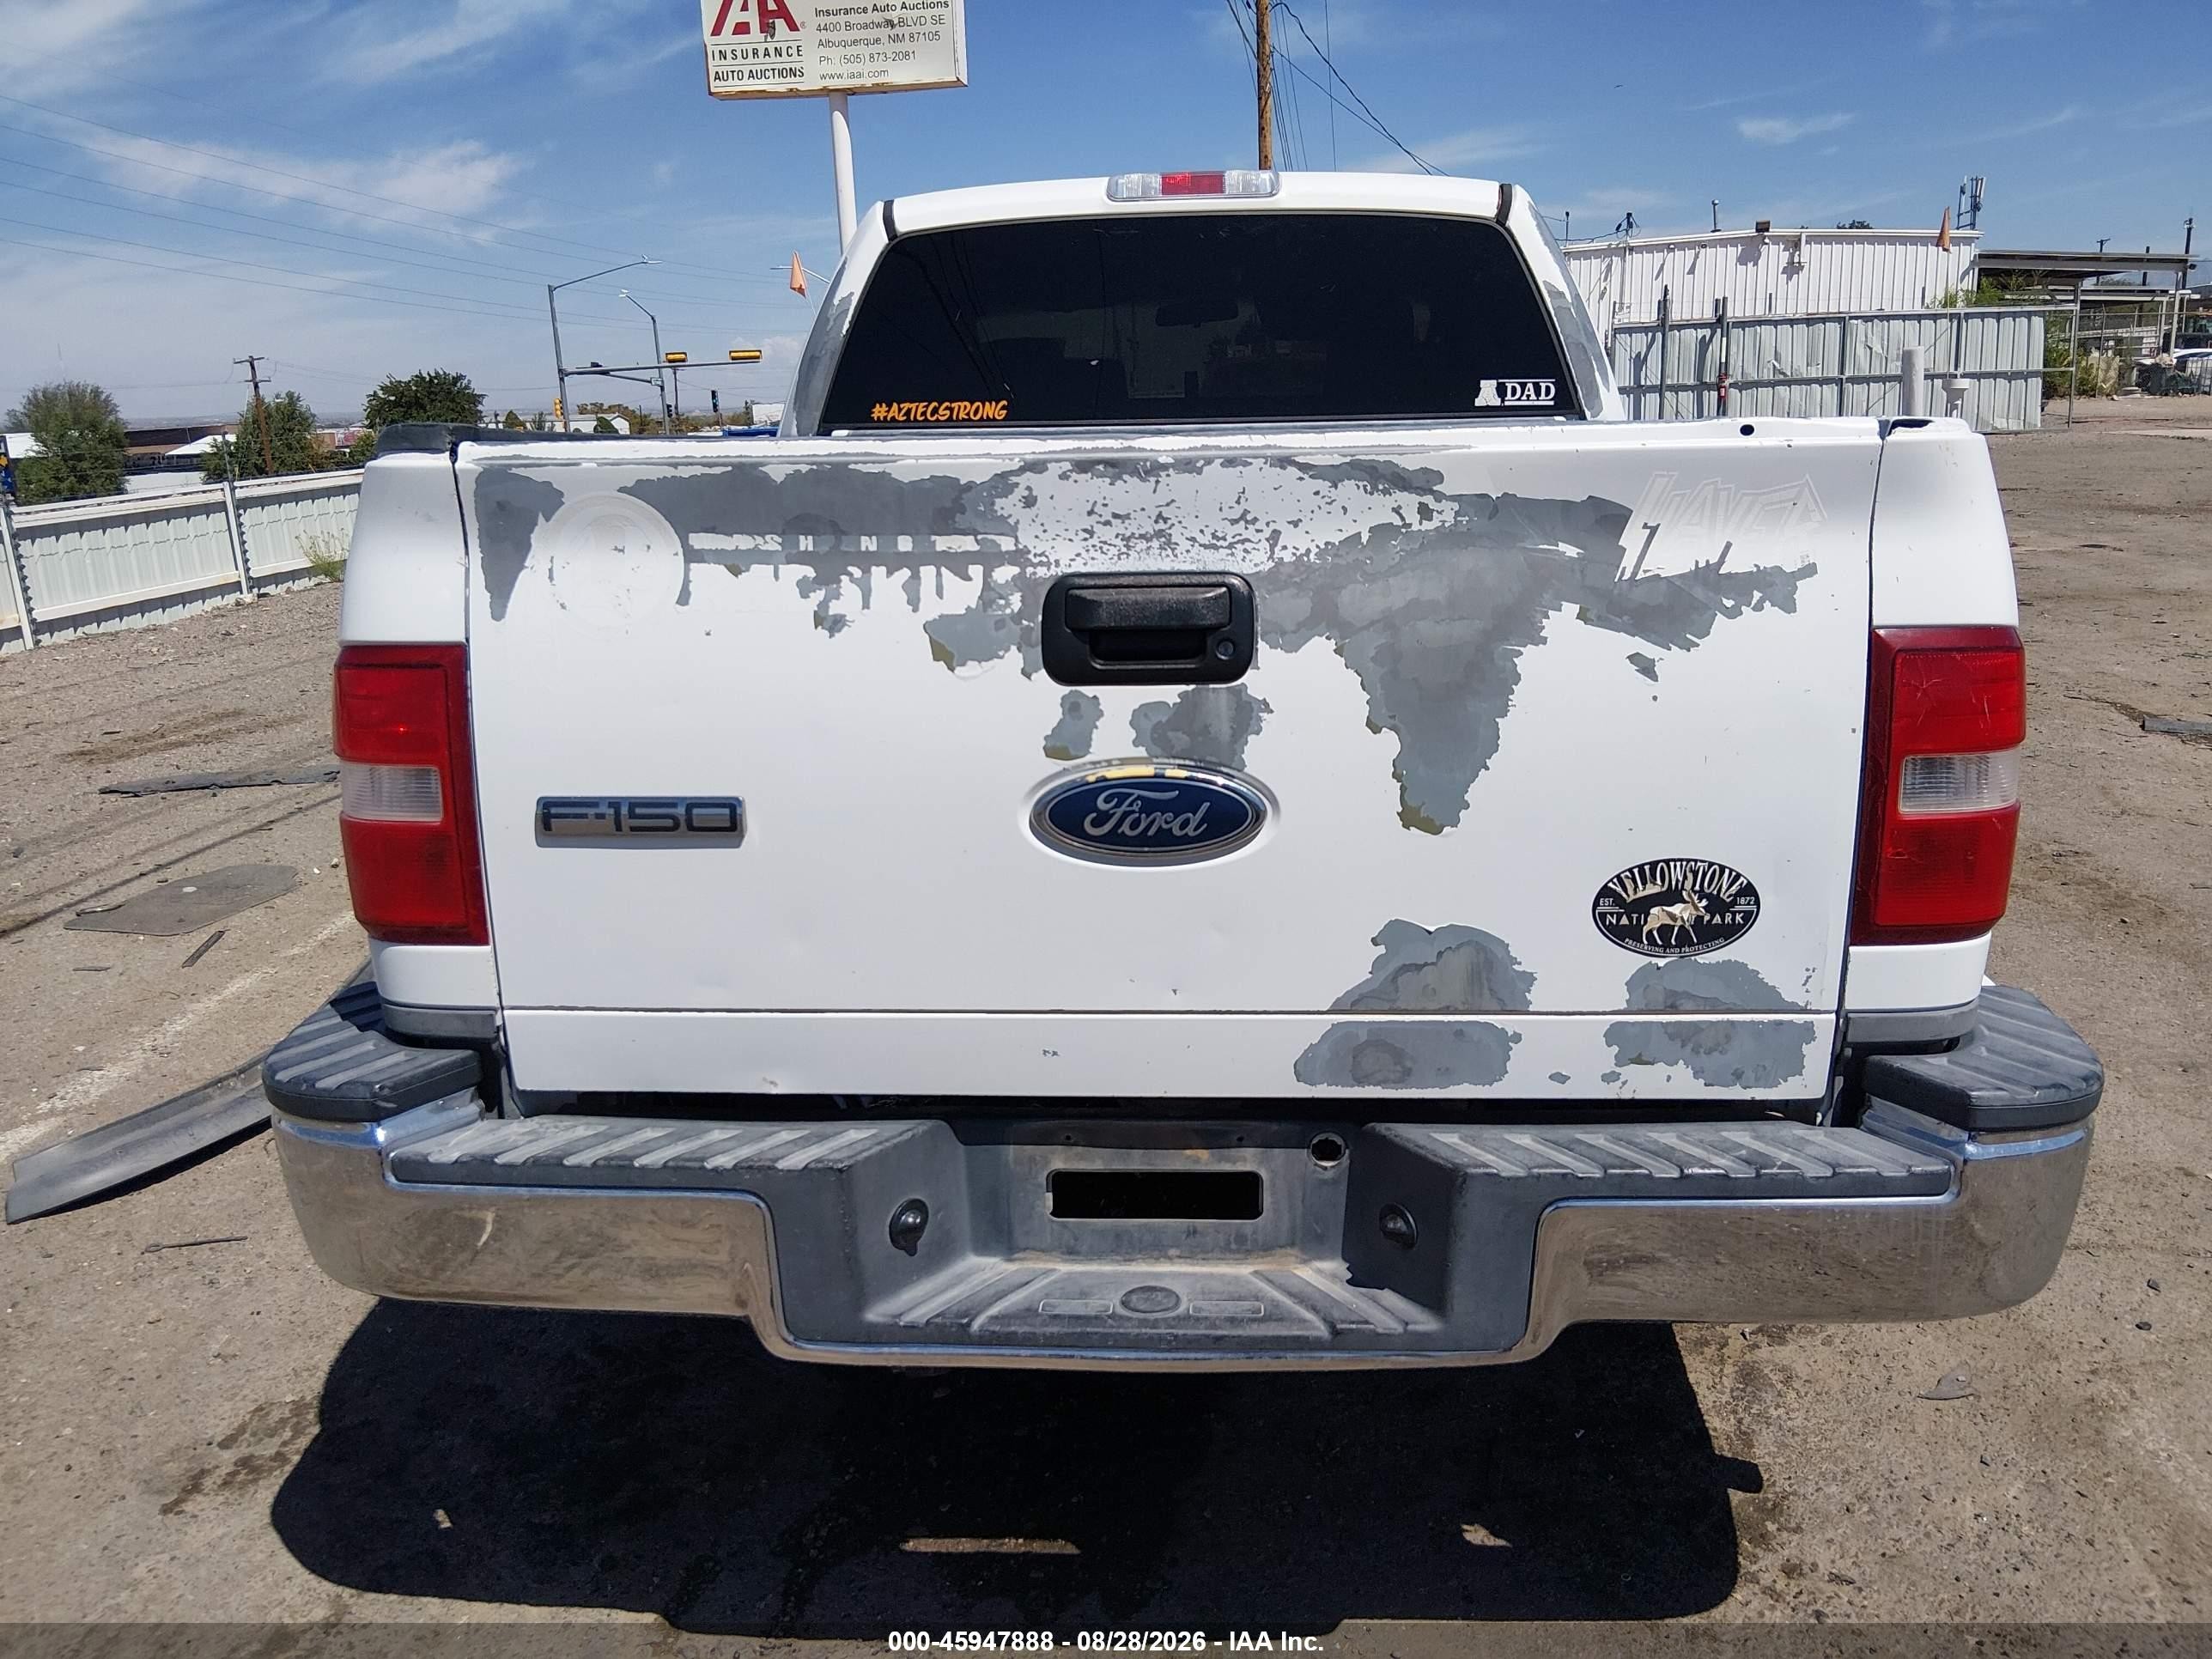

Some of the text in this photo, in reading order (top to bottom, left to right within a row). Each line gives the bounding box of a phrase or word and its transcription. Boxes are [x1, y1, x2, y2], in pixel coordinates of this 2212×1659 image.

[815, 0, 949, 17] Insurance Auto Auctions
[816, 15, 945, 33] 4400 Broadway BLVD SE
[817, 31, 941, 49] Albuquerque, NM 87105
[712, 46, 803, 61] INSURANCE
[819, 51, 916, 65] Ph: (505) 873-2081
[714, 66, 805, 82] AUTO AUCTIONS
[819, 69, 889, 81] www.iaai.com
[1504, 382, 1555, 400] DAD
[871, 400, 1007, 421] #AZTECSTRONG
[542, 800, 738, 832] F-150
[1083, 787, 1210, 837] Ford
[1607, 861, 1747, 903] YELLOWSTONE
[1599, 897, 1615, 906] EST.
[1704, 913, 1745, 925] PARK
[1624, 938, 1664, 953] PRESERVING
[1681, 937, 1725, 952] PROTECTING
